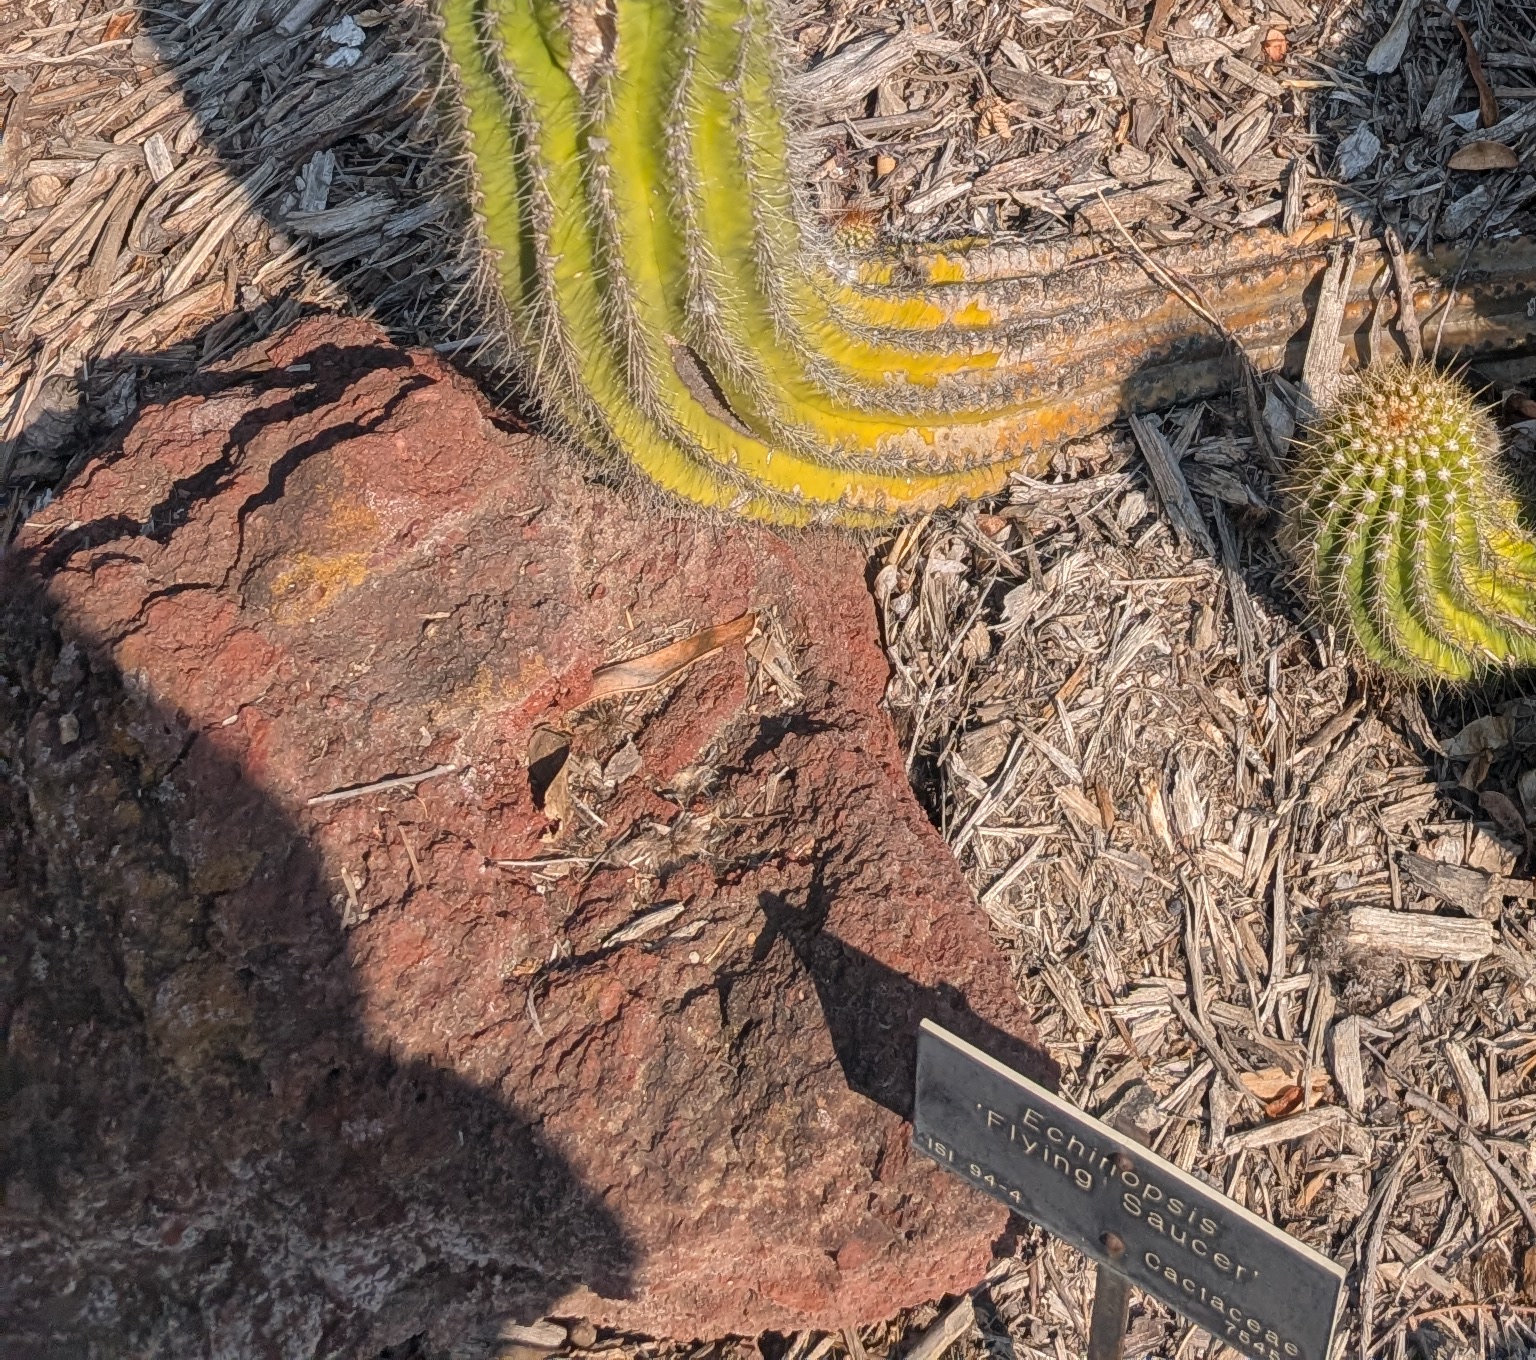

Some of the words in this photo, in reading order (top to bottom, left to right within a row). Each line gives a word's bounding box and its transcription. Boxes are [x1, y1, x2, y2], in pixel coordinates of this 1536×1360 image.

[927, 1137, 954, 1162] ISI
[969, 1163, 1021, 1204] 94-4
[1022, 1107, 1218, 1236] Echinopsis
[1122, 1192, 1260, 1280] Saucer'
[1145, 1251, 1299, 1357] Cactaceae
